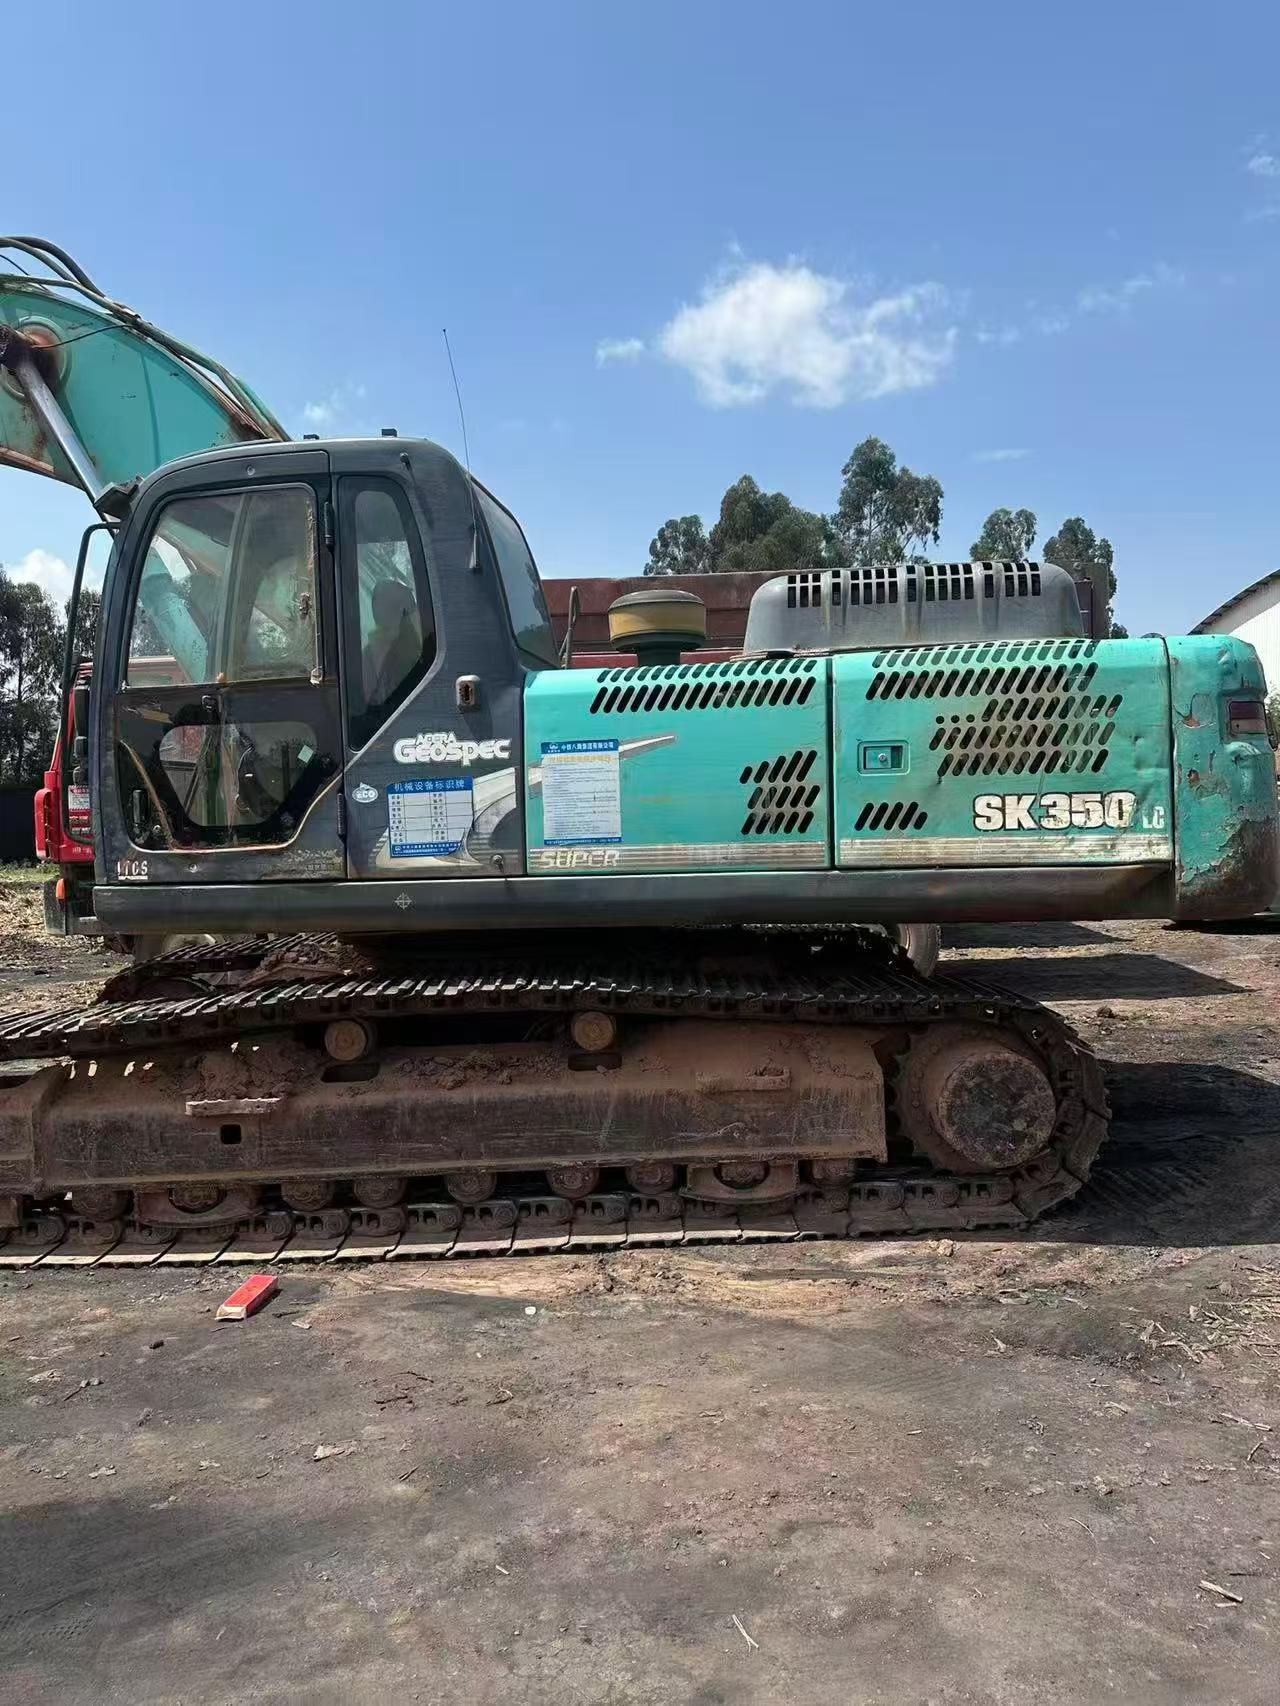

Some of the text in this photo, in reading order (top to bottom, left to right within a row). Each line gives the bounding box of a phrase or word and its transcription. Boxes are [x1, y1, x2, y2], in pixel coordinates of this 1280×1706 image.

[394, 779, 465, 792] 机械设备标识牌
[973, 791, 1165, 832] SK350 LC
[540, 849, 620, 869] SUPER
